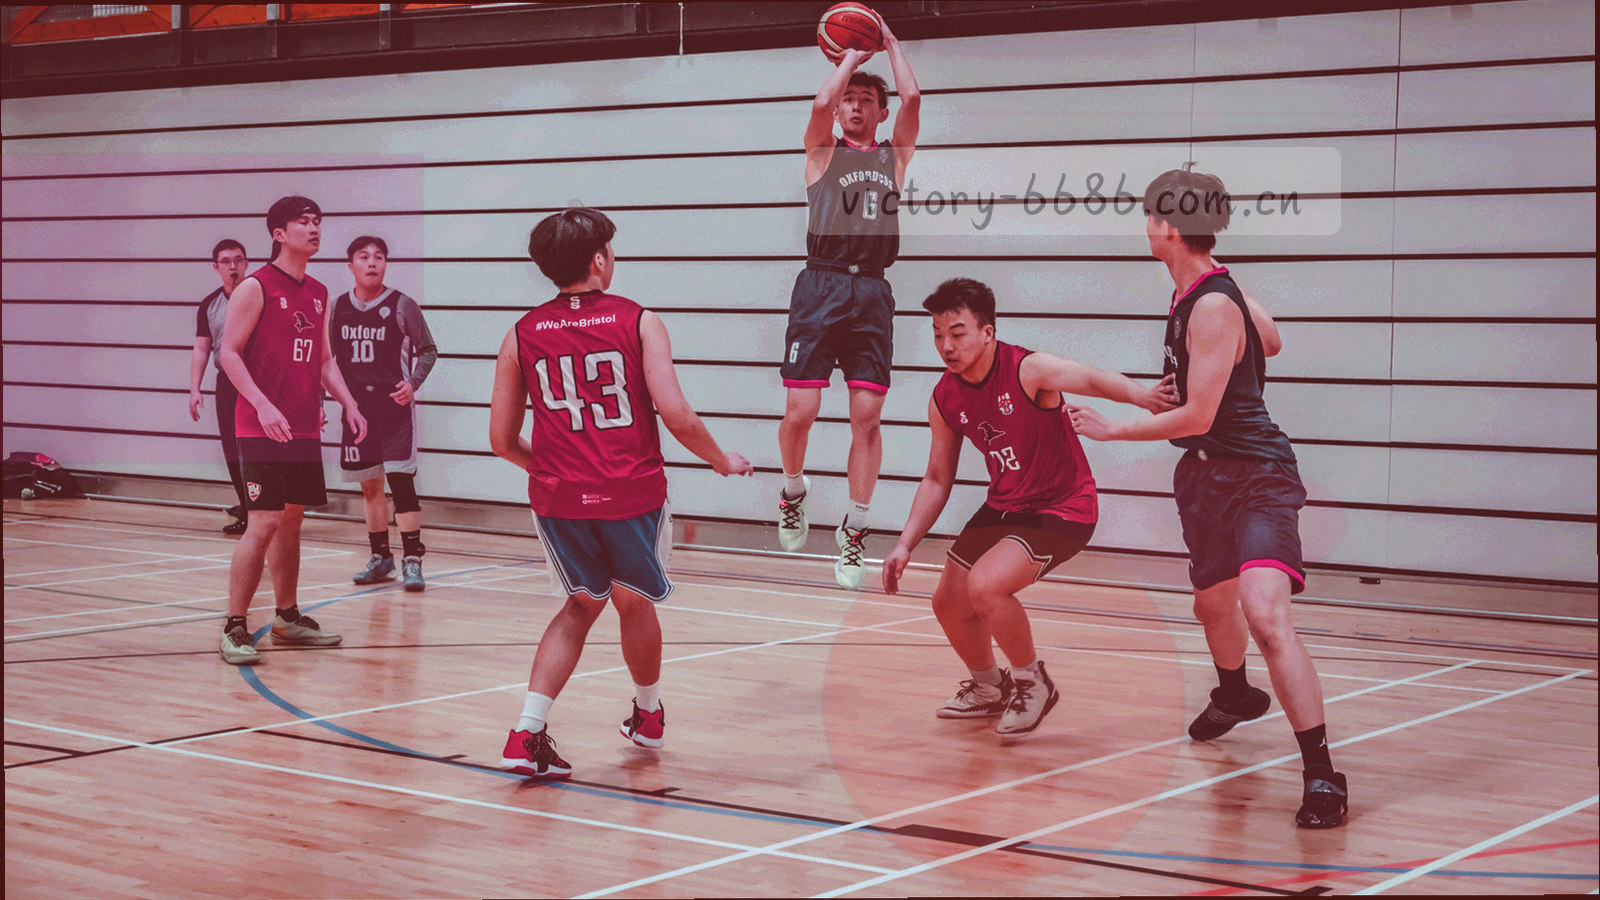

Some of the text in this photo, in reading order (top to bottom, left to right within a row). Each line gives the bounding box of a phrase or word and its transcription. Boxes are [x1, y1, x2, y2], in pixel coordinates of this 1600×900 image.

[341, 325, 386, 341] Oxford
[535, 314, 616, 331] #WeAreBristol
[292, 338, 313, 362] 67
[351, 340, 375, 363] 10
[789, 341, 800, 363] 6
[534, 350, 634, 432] 43
[344, 446, 361, 462] 10
